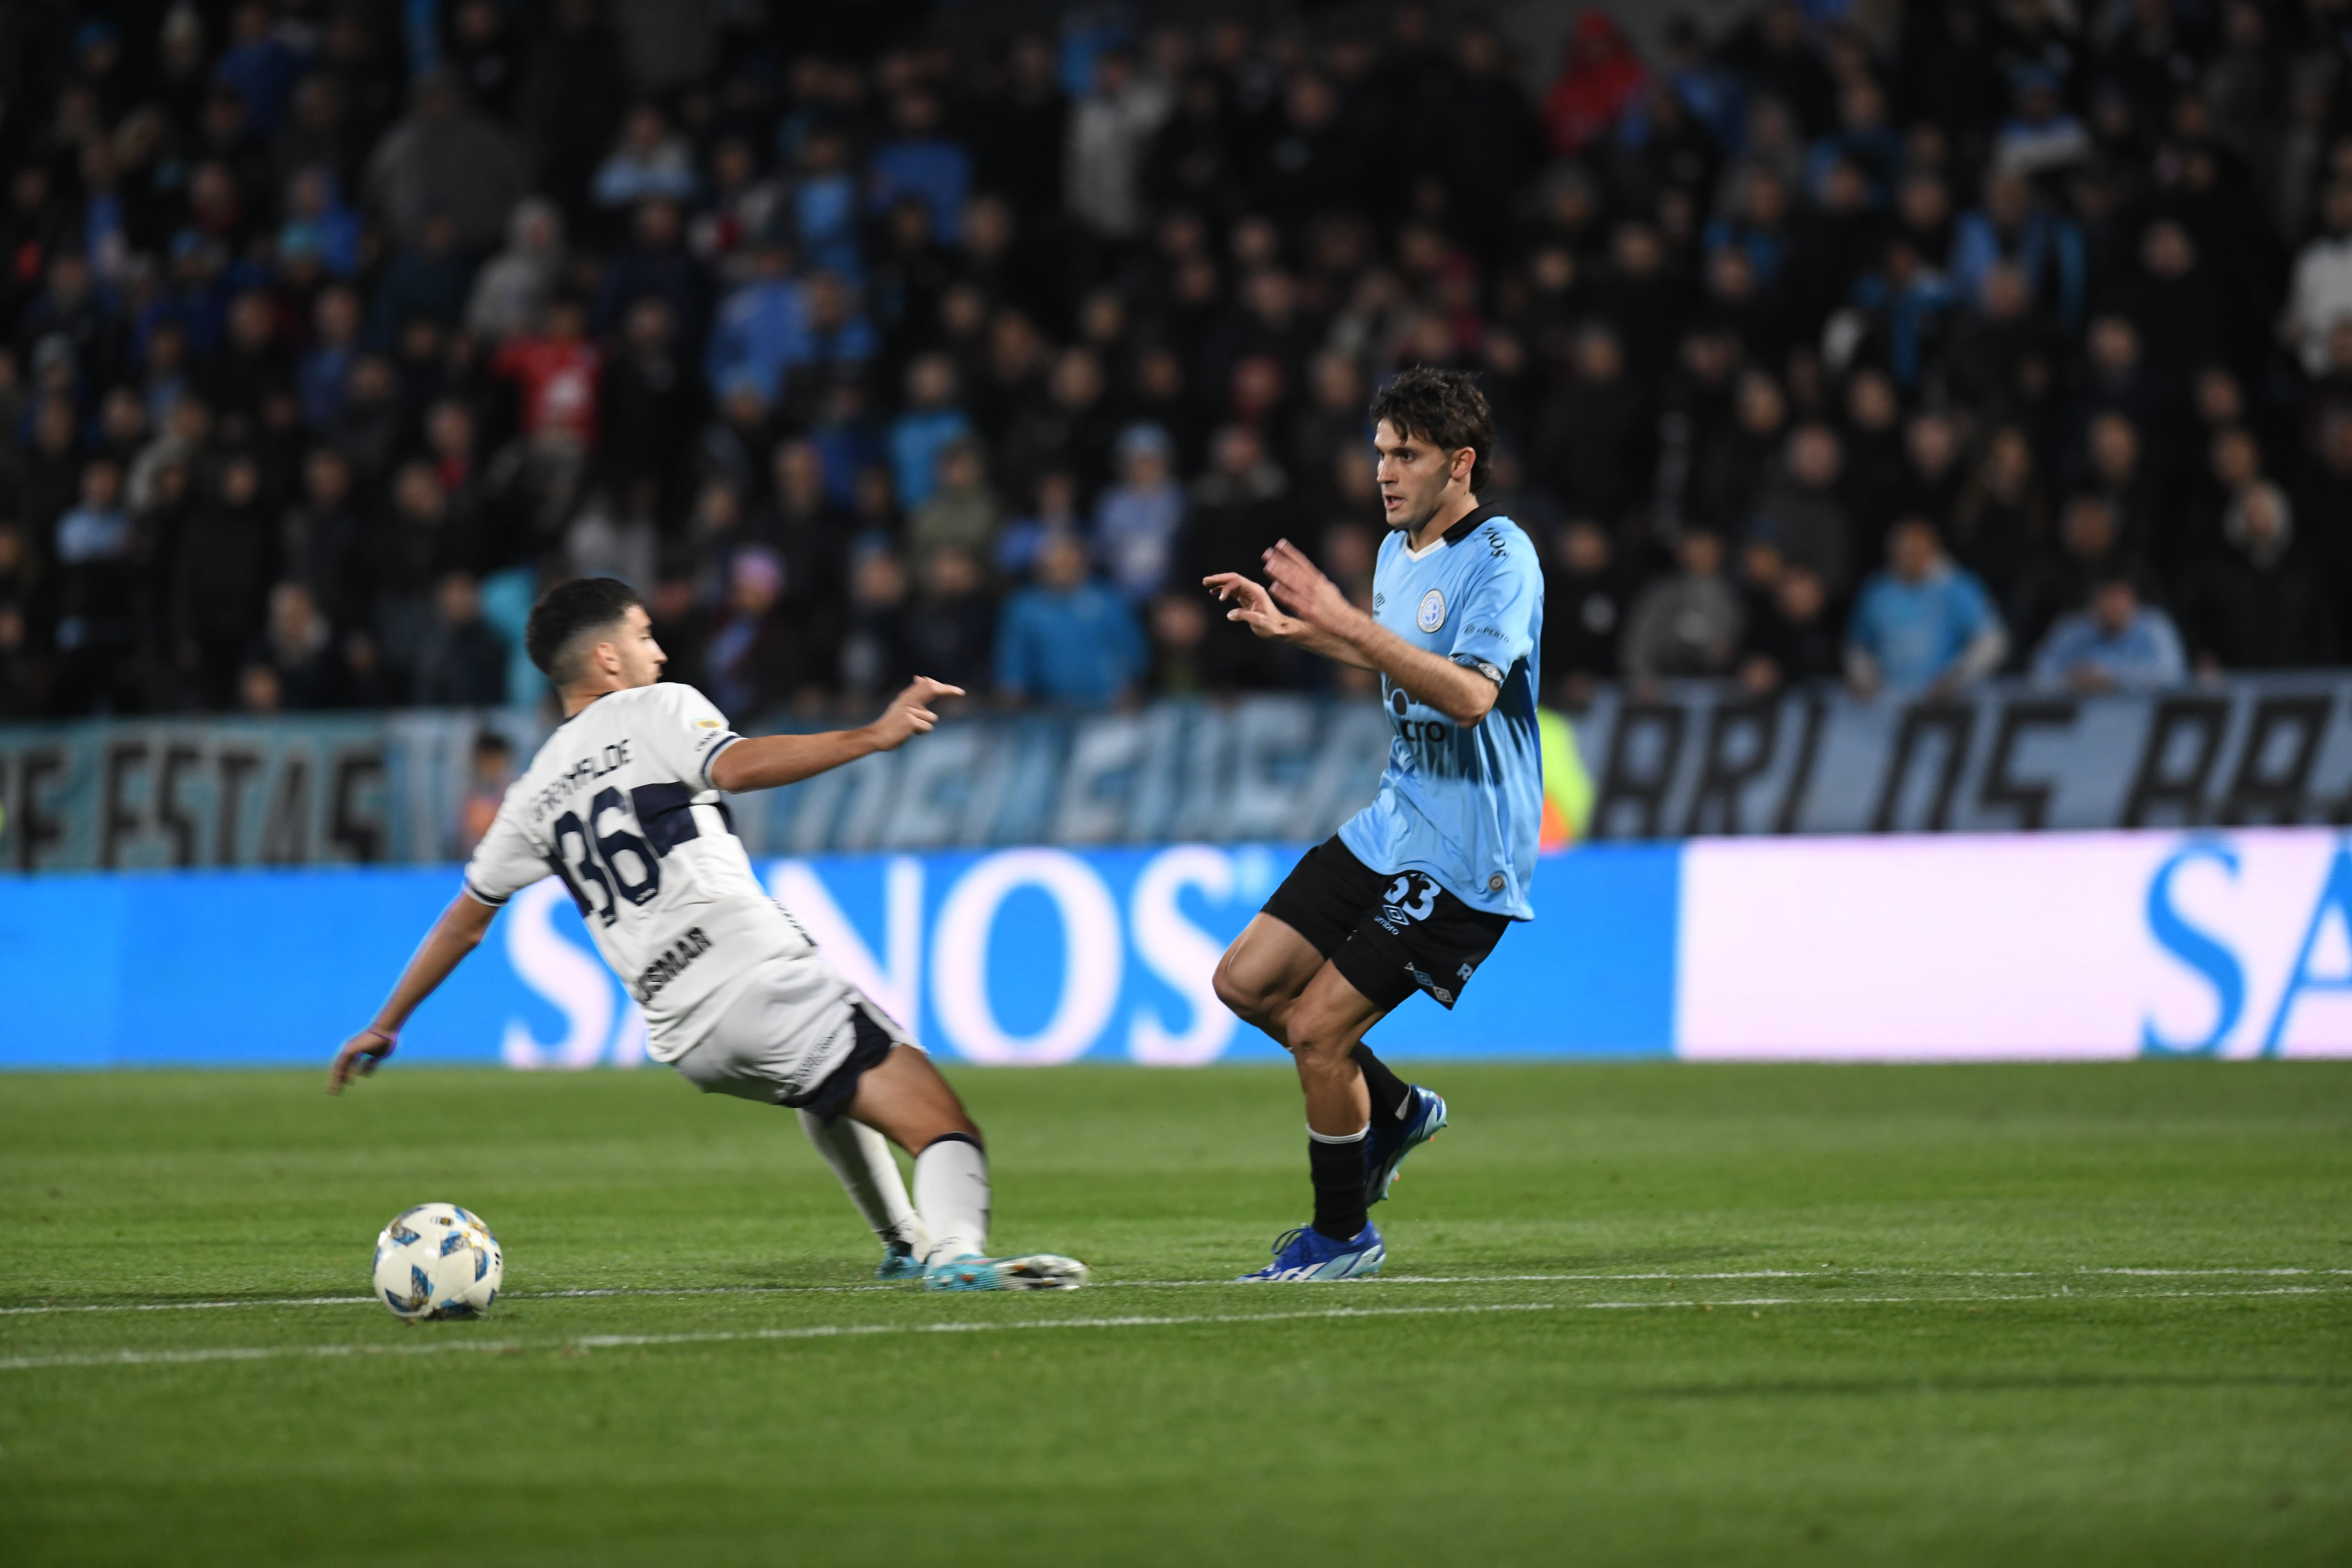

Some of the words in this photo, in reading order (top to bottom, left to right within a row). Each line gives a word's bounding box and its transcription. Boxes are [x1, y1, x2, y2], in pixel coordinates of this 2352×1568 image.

[553, 786, 660, 927] 36
[1374, 915, 1399, 935] umbro
[500, 844, 1240, 1067] SNOS
